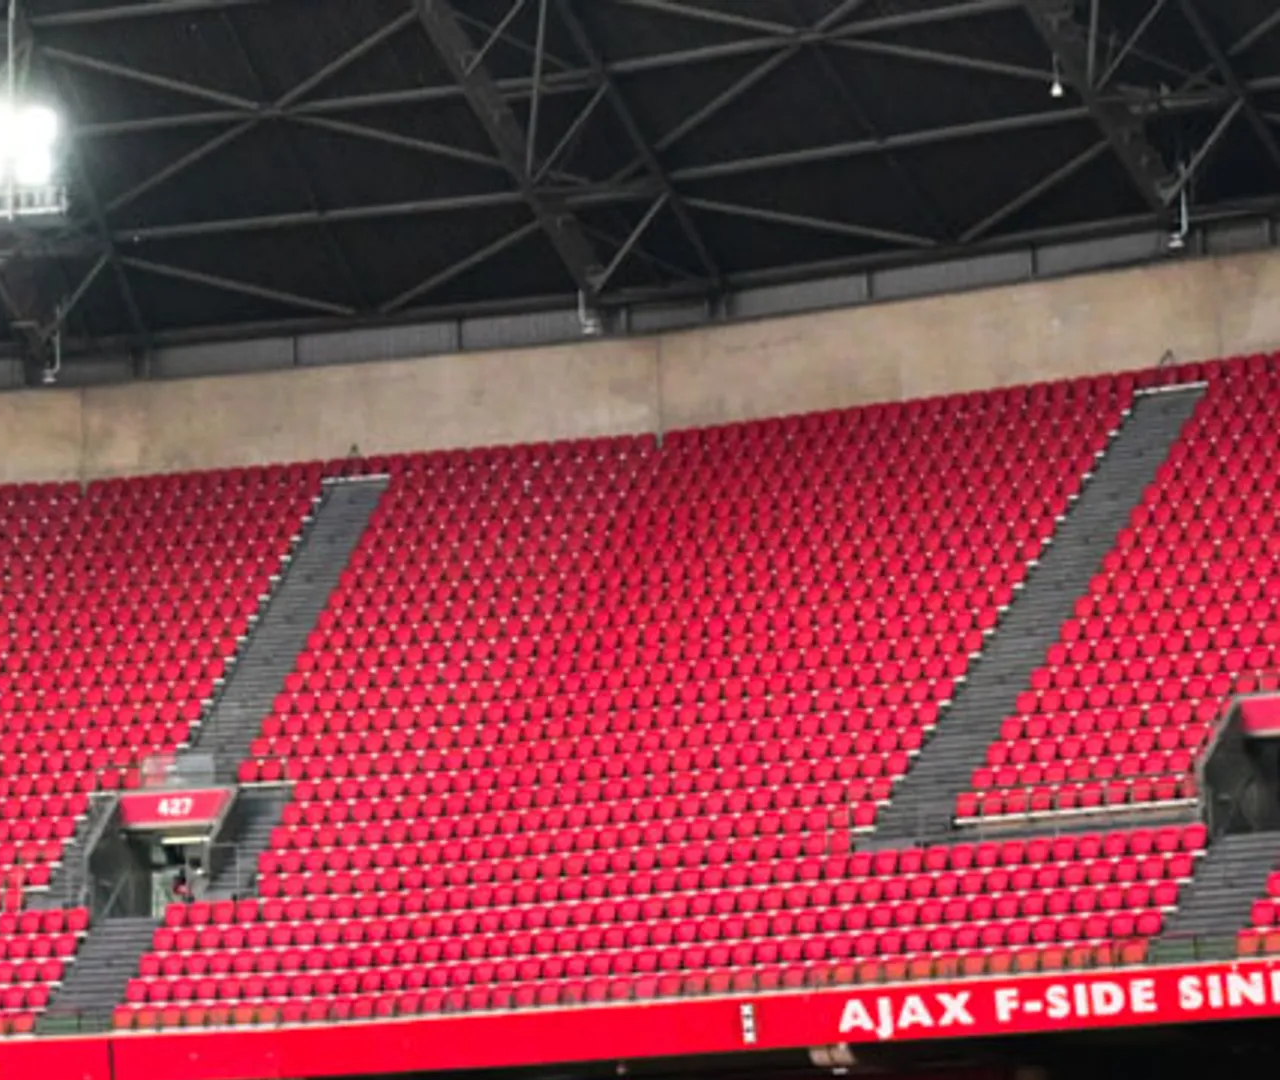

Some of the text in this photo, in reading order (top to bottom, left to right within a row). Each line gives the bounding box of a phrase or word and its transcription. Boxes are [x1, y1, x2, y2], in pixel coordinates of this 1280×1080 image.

[157, 797, 193, 816] 427
[838, 990, 975, 1039] AJAX
[993, 978, 1158, 1022] F-SIDE
